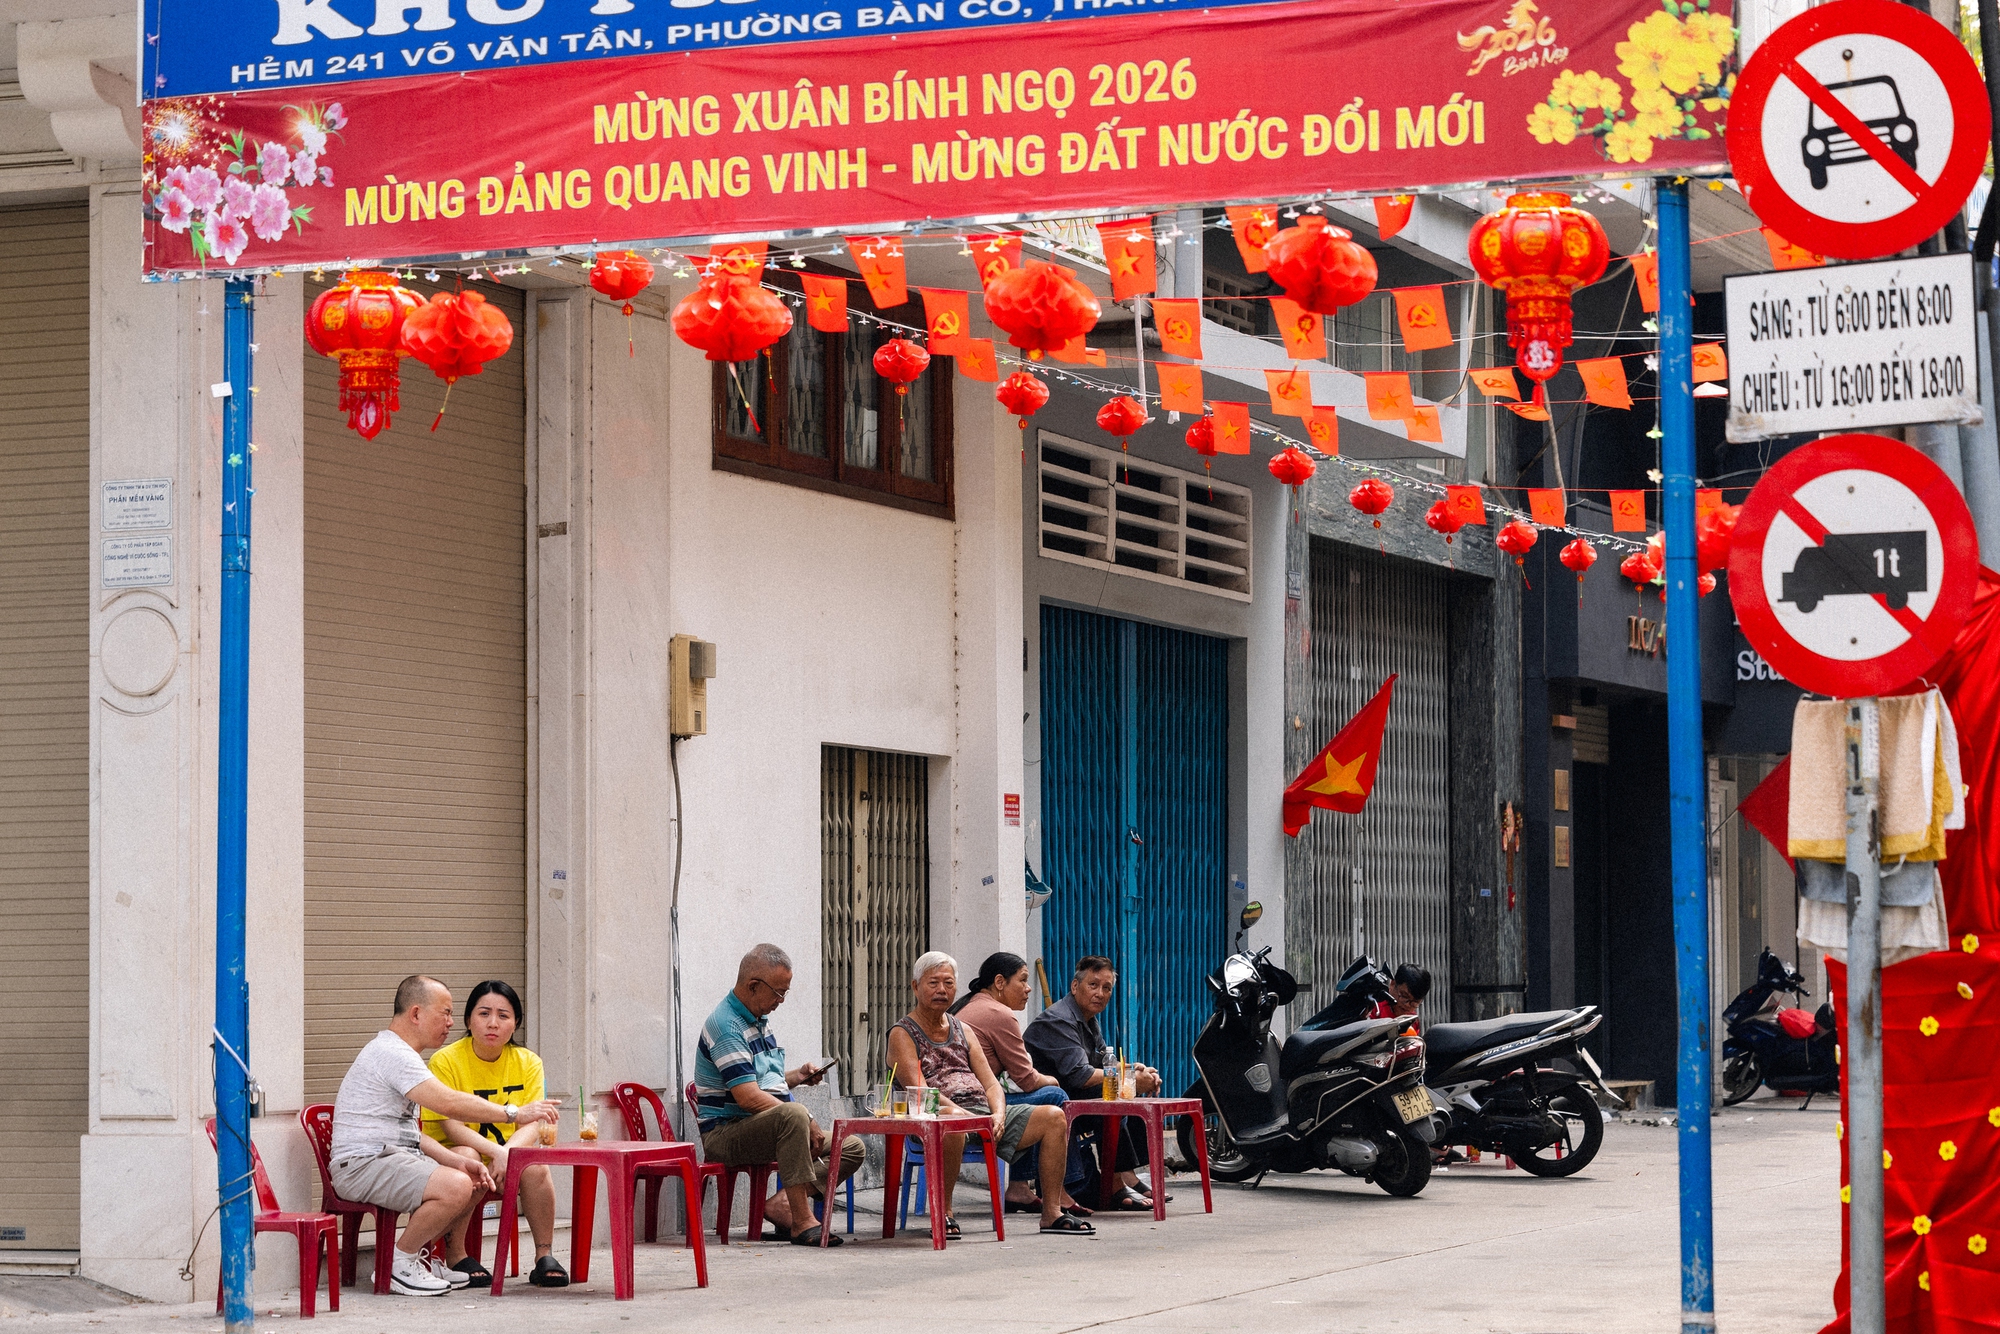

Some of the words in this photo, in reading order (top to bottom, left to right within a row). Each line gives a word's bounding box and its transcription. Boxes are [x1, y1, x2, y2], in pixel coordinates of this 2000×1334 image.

[232, 56, 313, 83] HẺM
[326, 52, 384, 75] 241
[401, 42, 455, 67] VÕ
[467, 36, 548, 61] VĂN
[561, 24, 653, 52] TẦN,
[667, 12, 842, 44] PHƯỜNG
[857, 0, 944, 28] BÀN
[593, 91, 721, 145] MỪNG
[732, 78, 850, 133] XUÂN
[863, 70, 968, 124] BÍNH
[982, 67, 1076, 118] NGỌ
[1088, 58, 1197, 107] 2026
[345, 177, 466, 226] MỪNG
[476, 162, 592, 215] ĐẢNG
[604, 156, 751, 211] QUANG
[762, 148, 868, 194] VINH
[912, 130, 1046, 185] MỪNG
[1057, 117, 1147, 173] ĐẤT
[1158, 109, 1289, 167] NƯỚC
[1300, 97, 1380, 157] ĐỔI
[1395, 92, 1486, 150] MỚI
[1750, 289, 1792, 342] SÁNG
[1807, 280, 1830, 336] TỪ
[1835, 292, 1871, 334] 6:00
[1876, 269, 1911, 330] ĐẾN
[1917, 284, 1952, 327] 8:00
[1742, 354, 1790, 414] CHIỀU
[1803, 352, 1824, 408] TỪ
[1831, 364, 1874, 407] 16:00
[1880, 341, 1913, 402] ĐẾN
[1920, 355, 1964, 399] 18:00
[1873, 548, 1900, 578] 1t
[1398, 1088, 1424, 1107] 59-H1
[1401, 1100, 1434, 1121] 673.45
